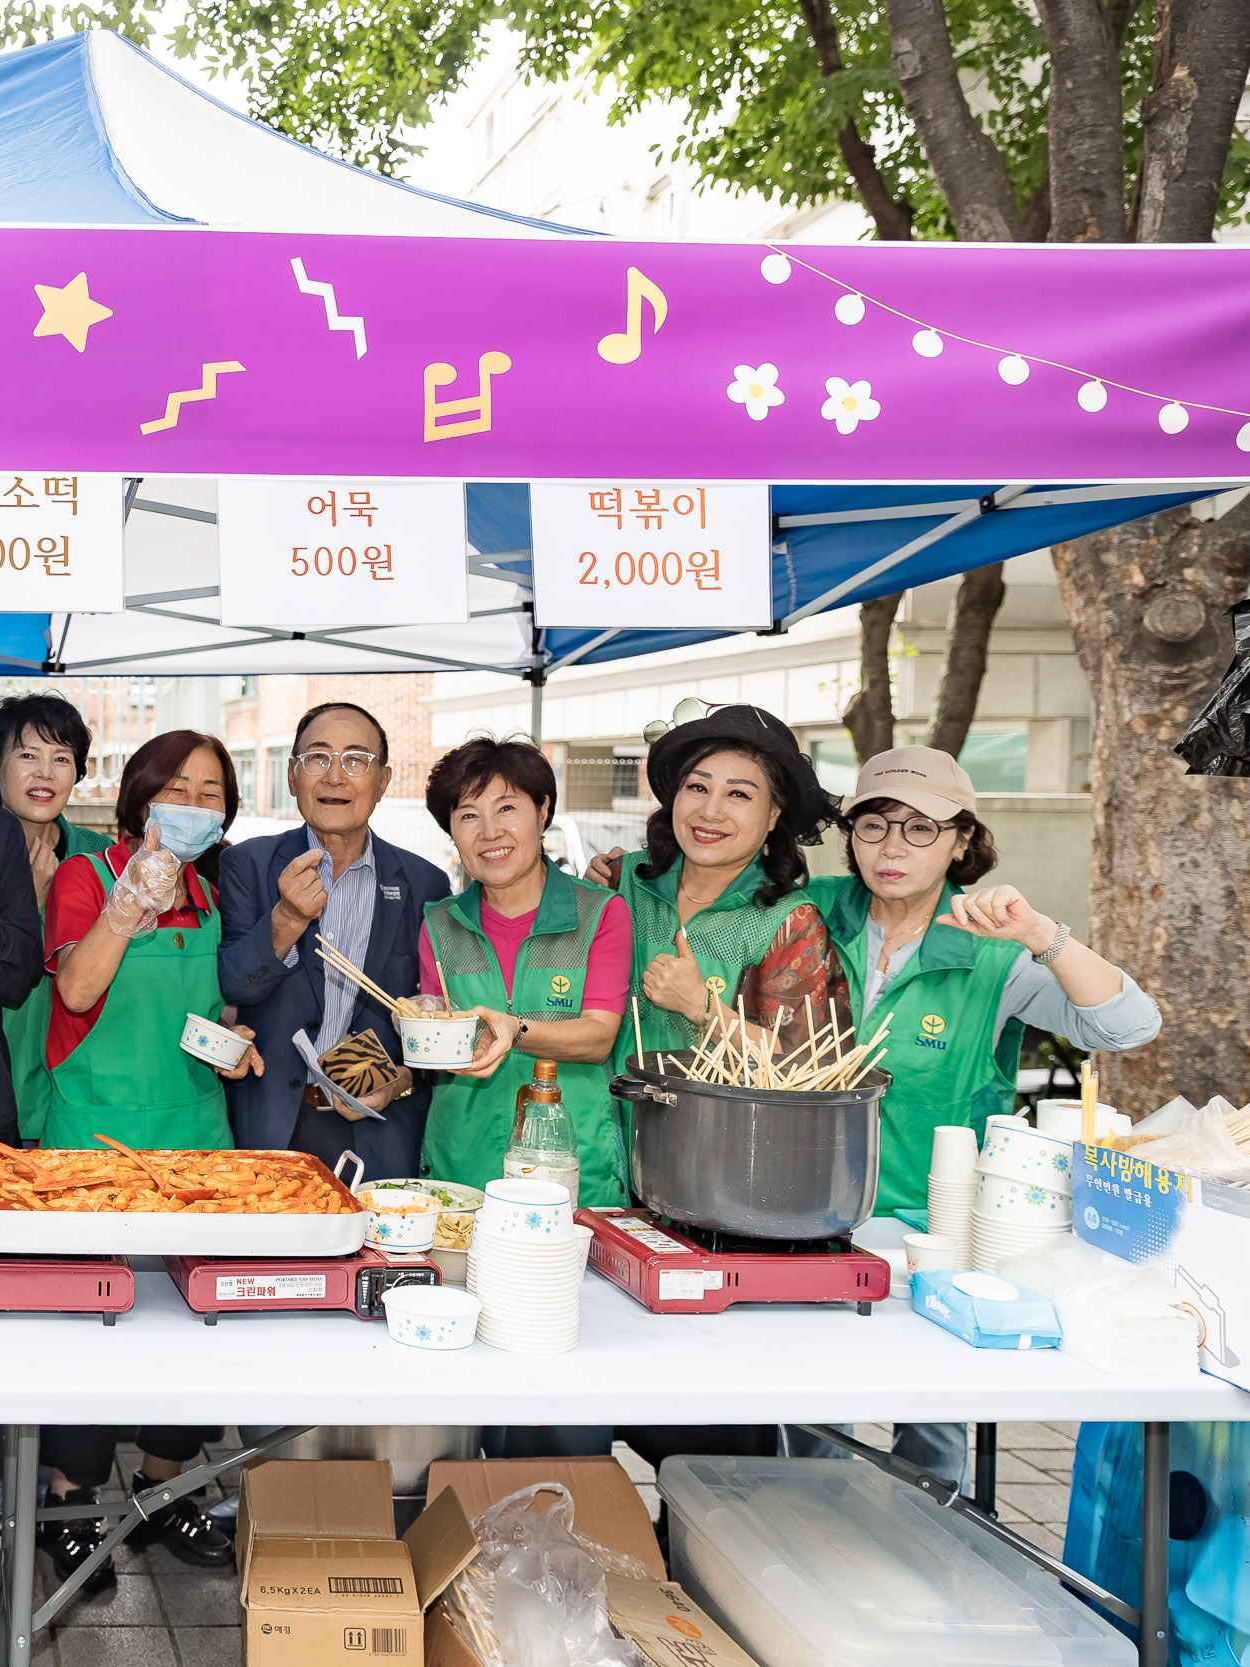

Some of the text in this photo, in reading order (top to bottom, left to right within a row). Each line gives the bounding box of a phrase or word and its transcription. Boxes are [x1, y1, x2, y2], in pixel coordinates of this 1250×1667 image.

[307, 490, 378, 527] 어묵
[588, 487, 706, 530] 떡볶이
[291, 544, 395, 580] 500원
[578, 549, 723, 591] 2,000원
[546, 996, 573, 1008] SMU
[914, 1036, 947, 1050] SMU
[236, 1286, 276, 1297] 크린파워
